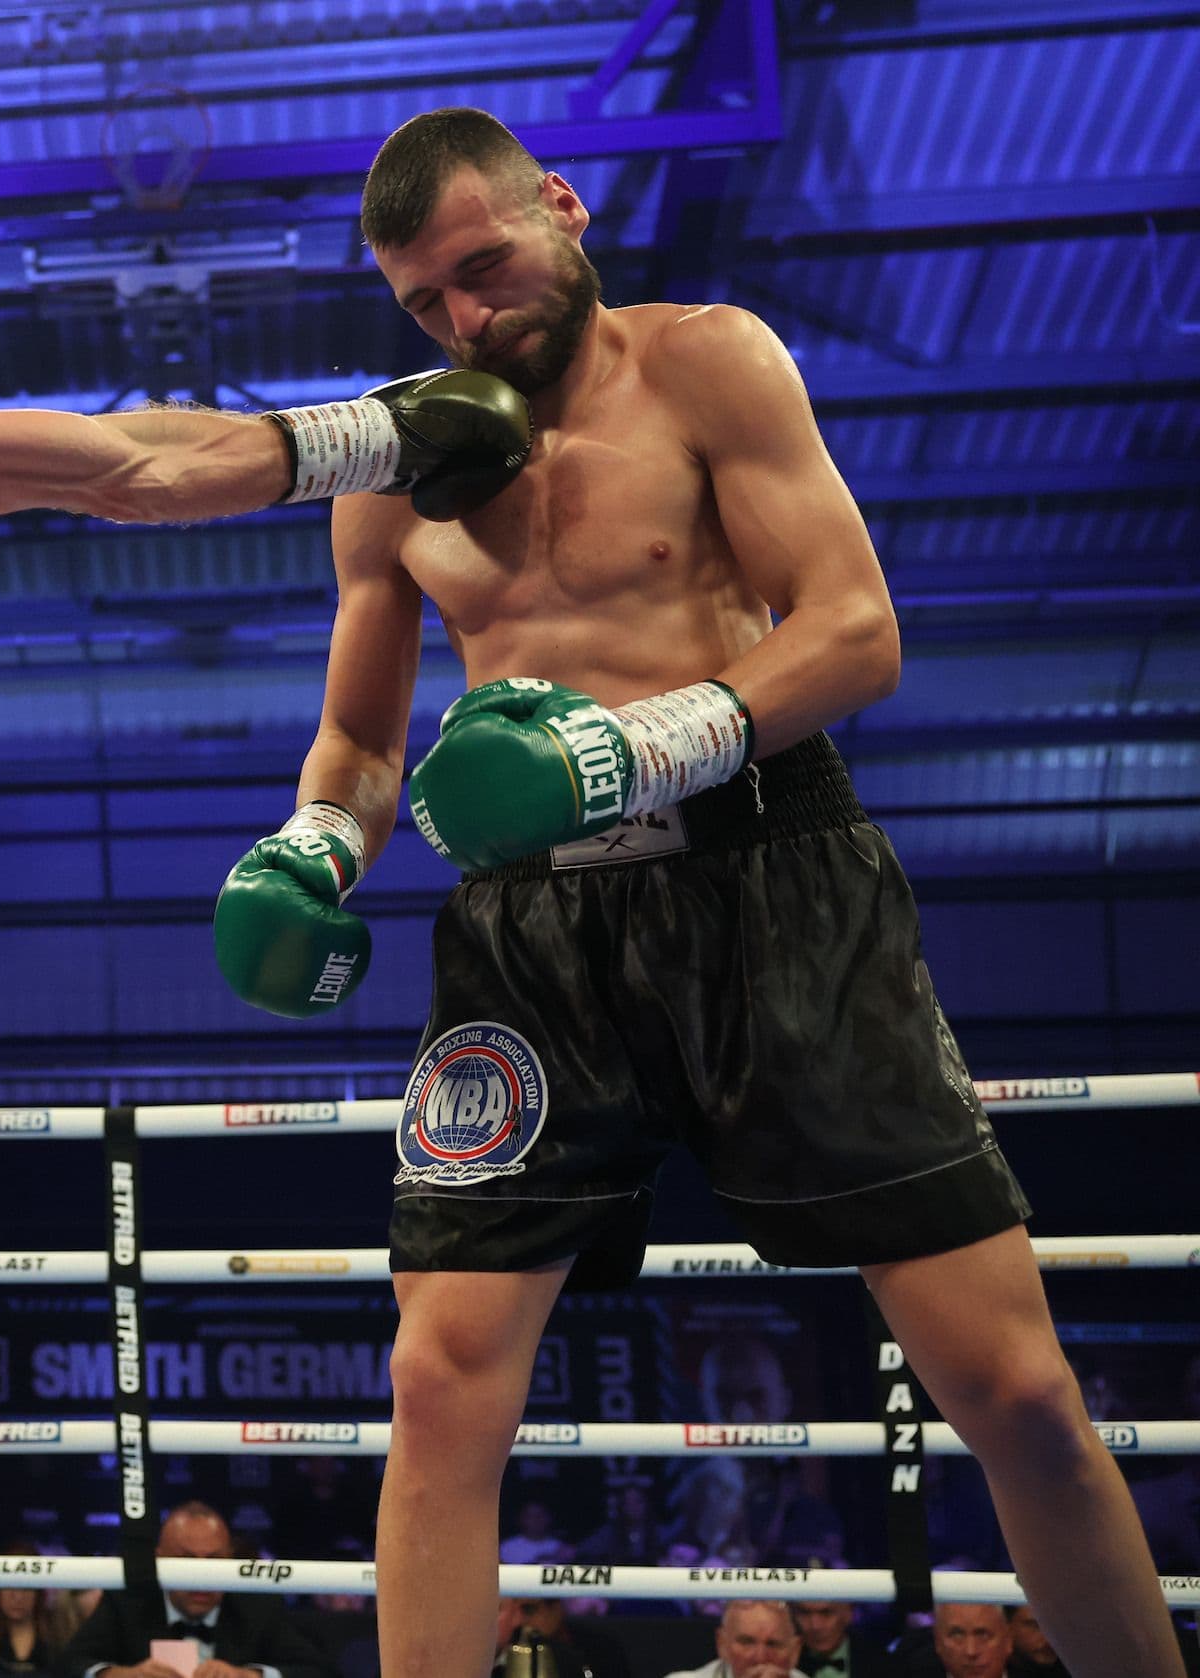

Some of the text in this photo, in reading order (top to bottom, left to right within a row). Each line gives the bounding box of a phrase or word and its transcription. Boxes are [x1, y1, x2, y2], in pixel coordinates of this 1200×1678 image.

[546, 704, 623, 824] LEONE
[409, 797, 451, 857] LEONE
[309, 952, 358, 1003] LEONE
[406, 1030, 540, 1111] WORLD BOXING ASSOCIATION
[226, 1103, 337, 1125] BETFRED
[425, 1074, 507, 1134] WBA
[111, 1161, 136, 1266] BETFRED
[114, 1285, 140, 1394] BETFRED
[31, 1342, 207, 1399] SMTH
[243, 1422, 358, 1443] BETFRED
[513, 1423, 578, 1443] FRED
[687, 1424, 804, 1444] BETFRED
[878, 1341, 922, 1494] DAZN
[119, 1412, 146, 1520] BETFRED
[238, 1558, 293, 1583] drip
[540, 1566, 813, 1585] DAZN EVERLAST
